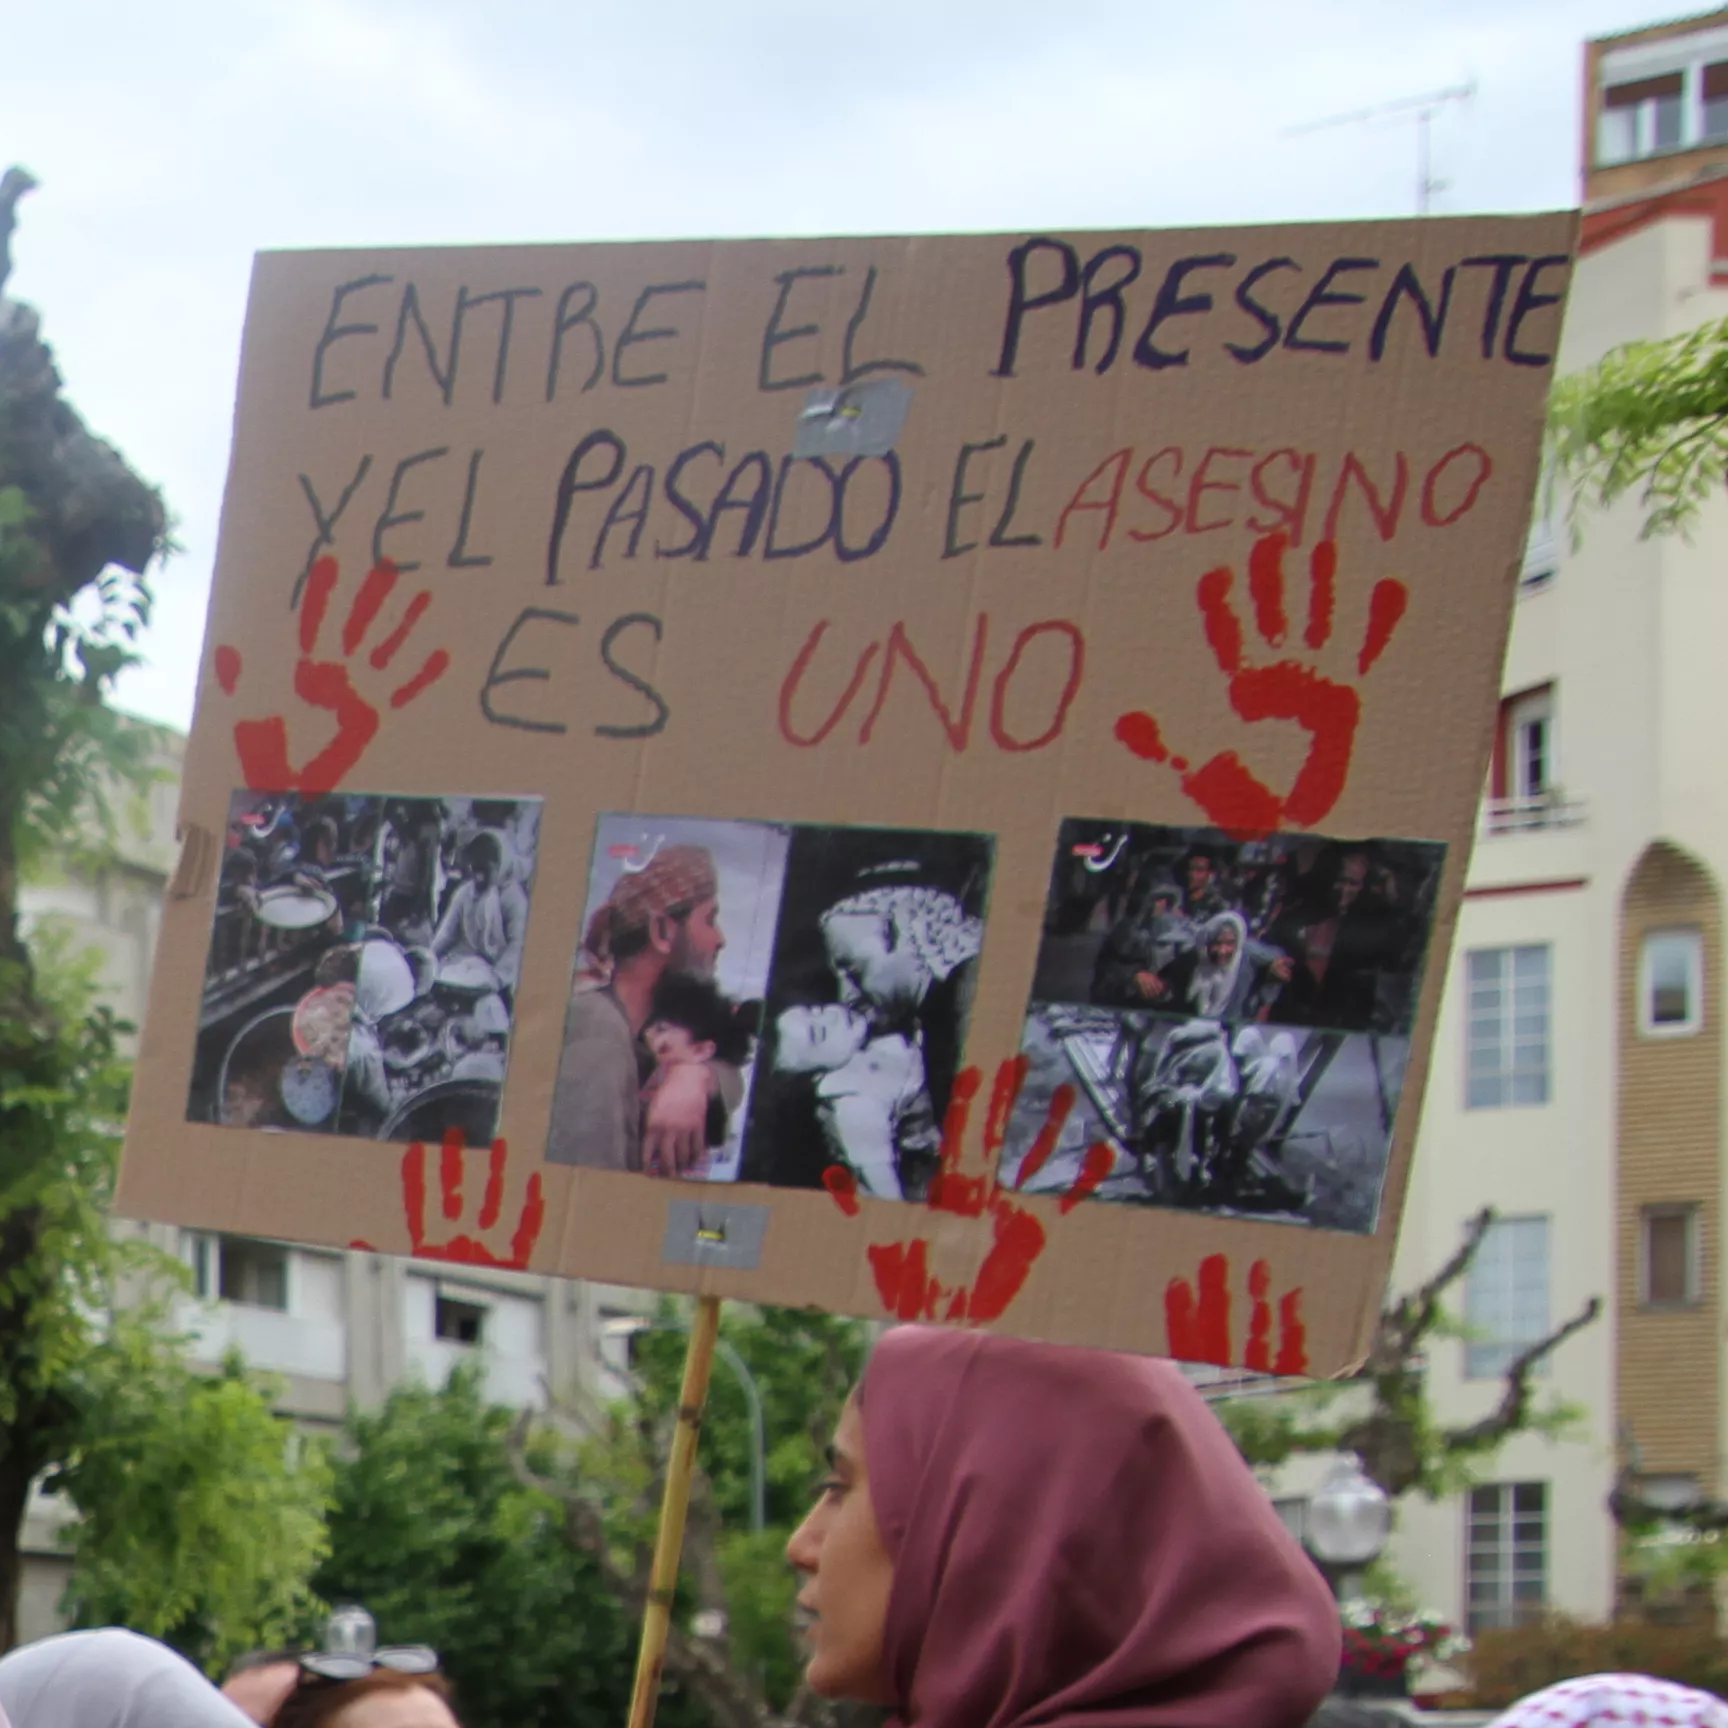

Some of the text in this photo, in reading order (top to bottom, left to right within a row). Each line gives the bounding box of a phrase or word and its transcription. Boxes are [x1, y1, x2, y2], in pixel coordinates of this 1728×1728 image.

[308, 237, 1571, 410] ENTRE EL PRESENTE
[544, 428, 904, 587] PASADO
[940, 434, 1044, 561] EL
[1053, 442, 1492, 551] ASESINO
[480, 607, 1086, 754] ES UNO
